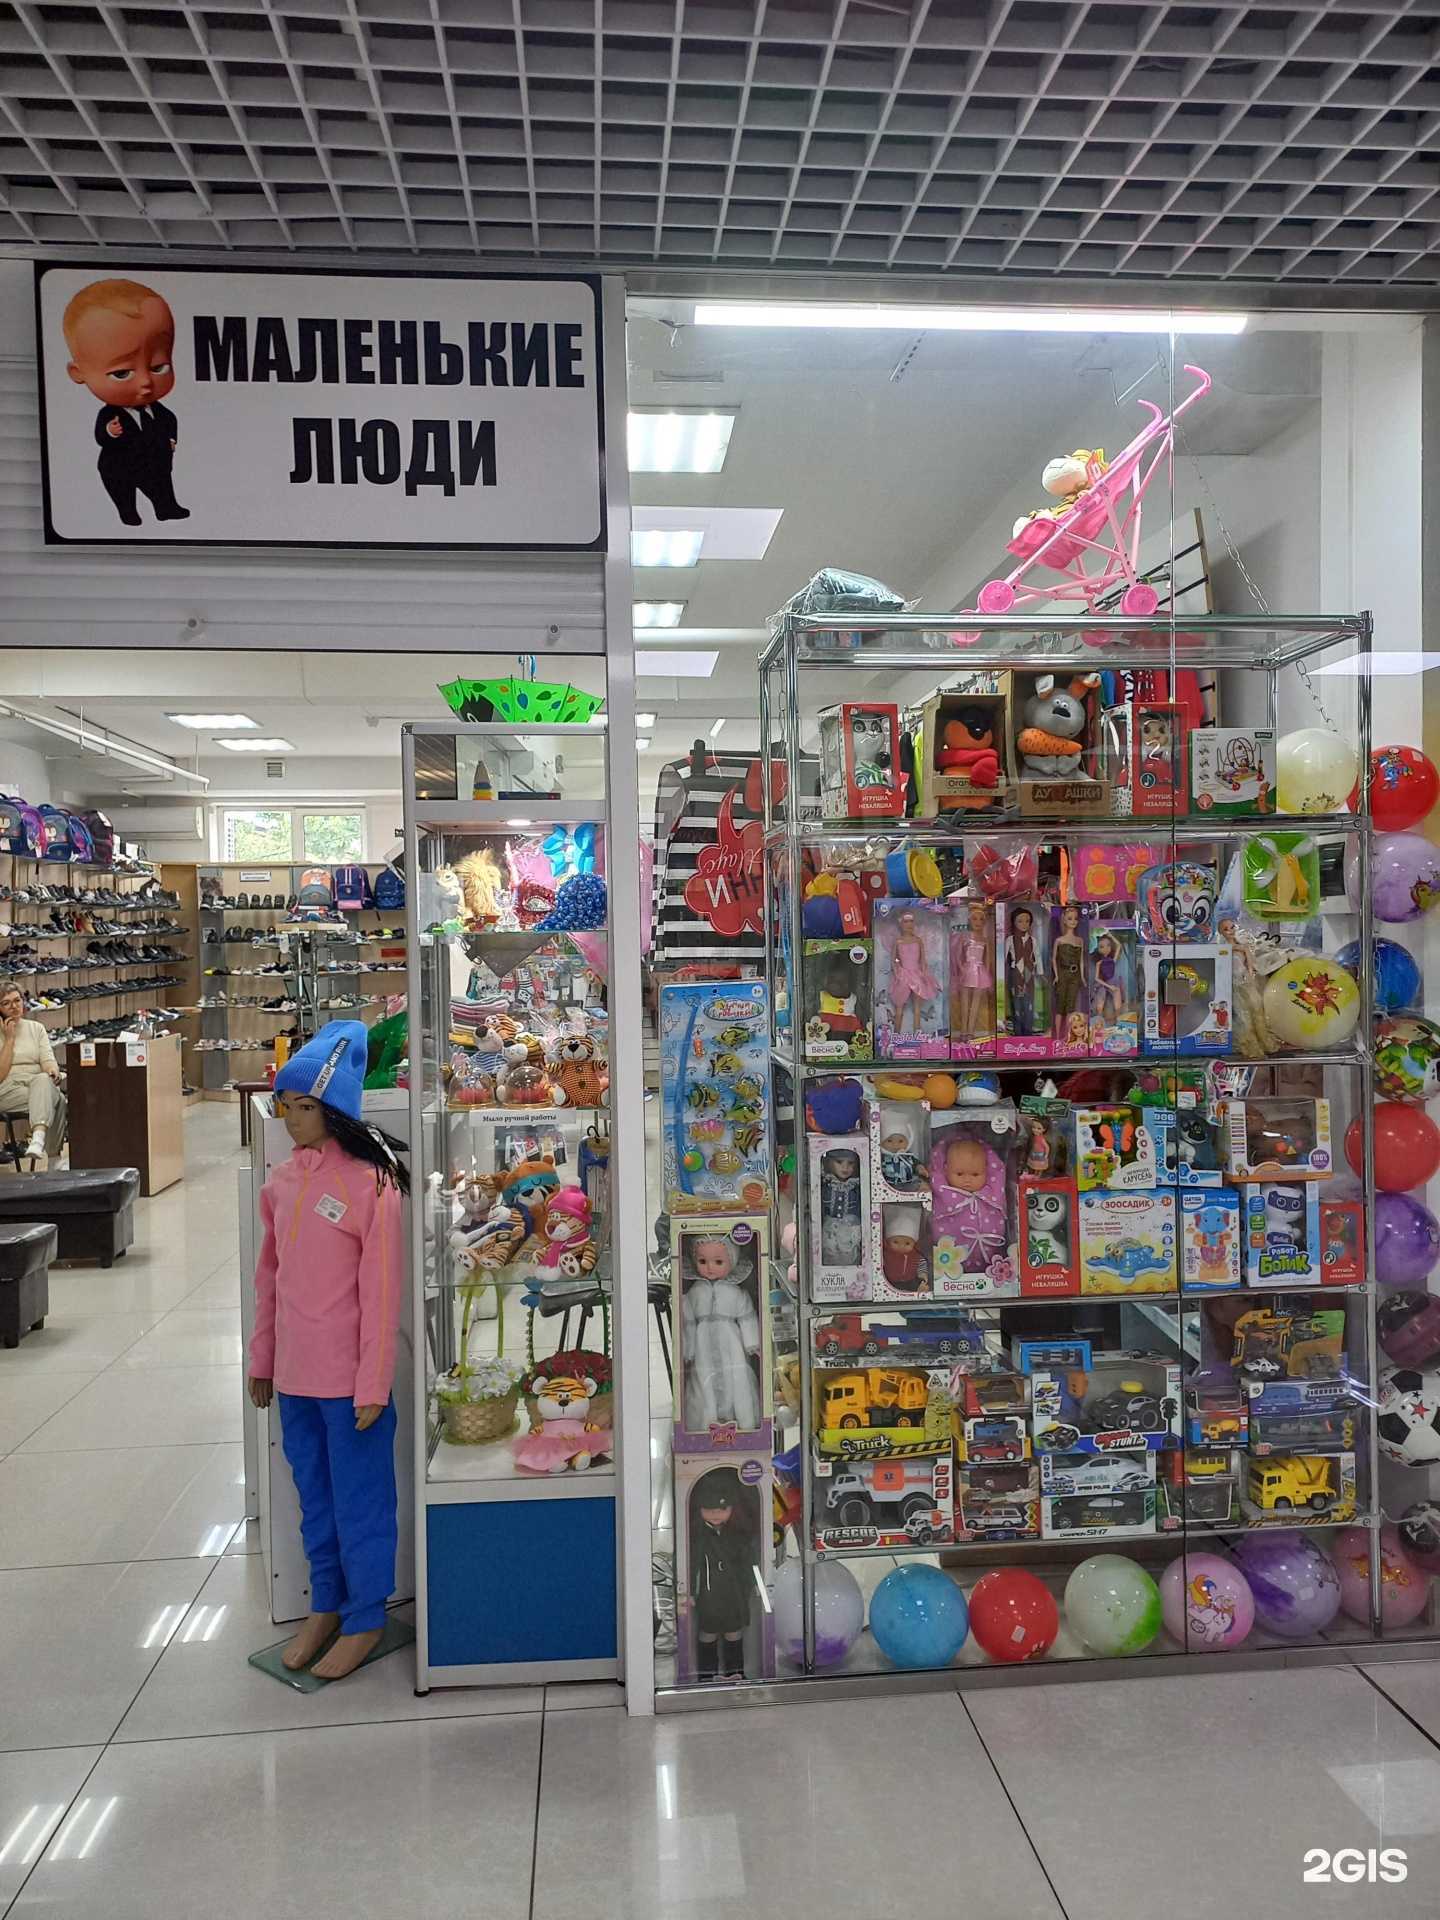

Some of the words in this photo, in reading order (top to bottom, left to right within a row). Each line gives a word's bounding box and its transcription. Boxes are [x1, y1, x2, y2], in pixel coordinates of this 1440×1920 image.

[193, 315, 585, 389] МАЛЕНЬКИЕ
[290, 417, 497, 497] ЛЮДИ
[316, 1074, 328, 1089] GET
[505, 1114, 530, 1122] ручной
[531, 1113, 557, 1122] работы
[1105, 1200, 1151, 1209] ЗООСАДИК
[826, 1527, 877, 1540] RESCUE
